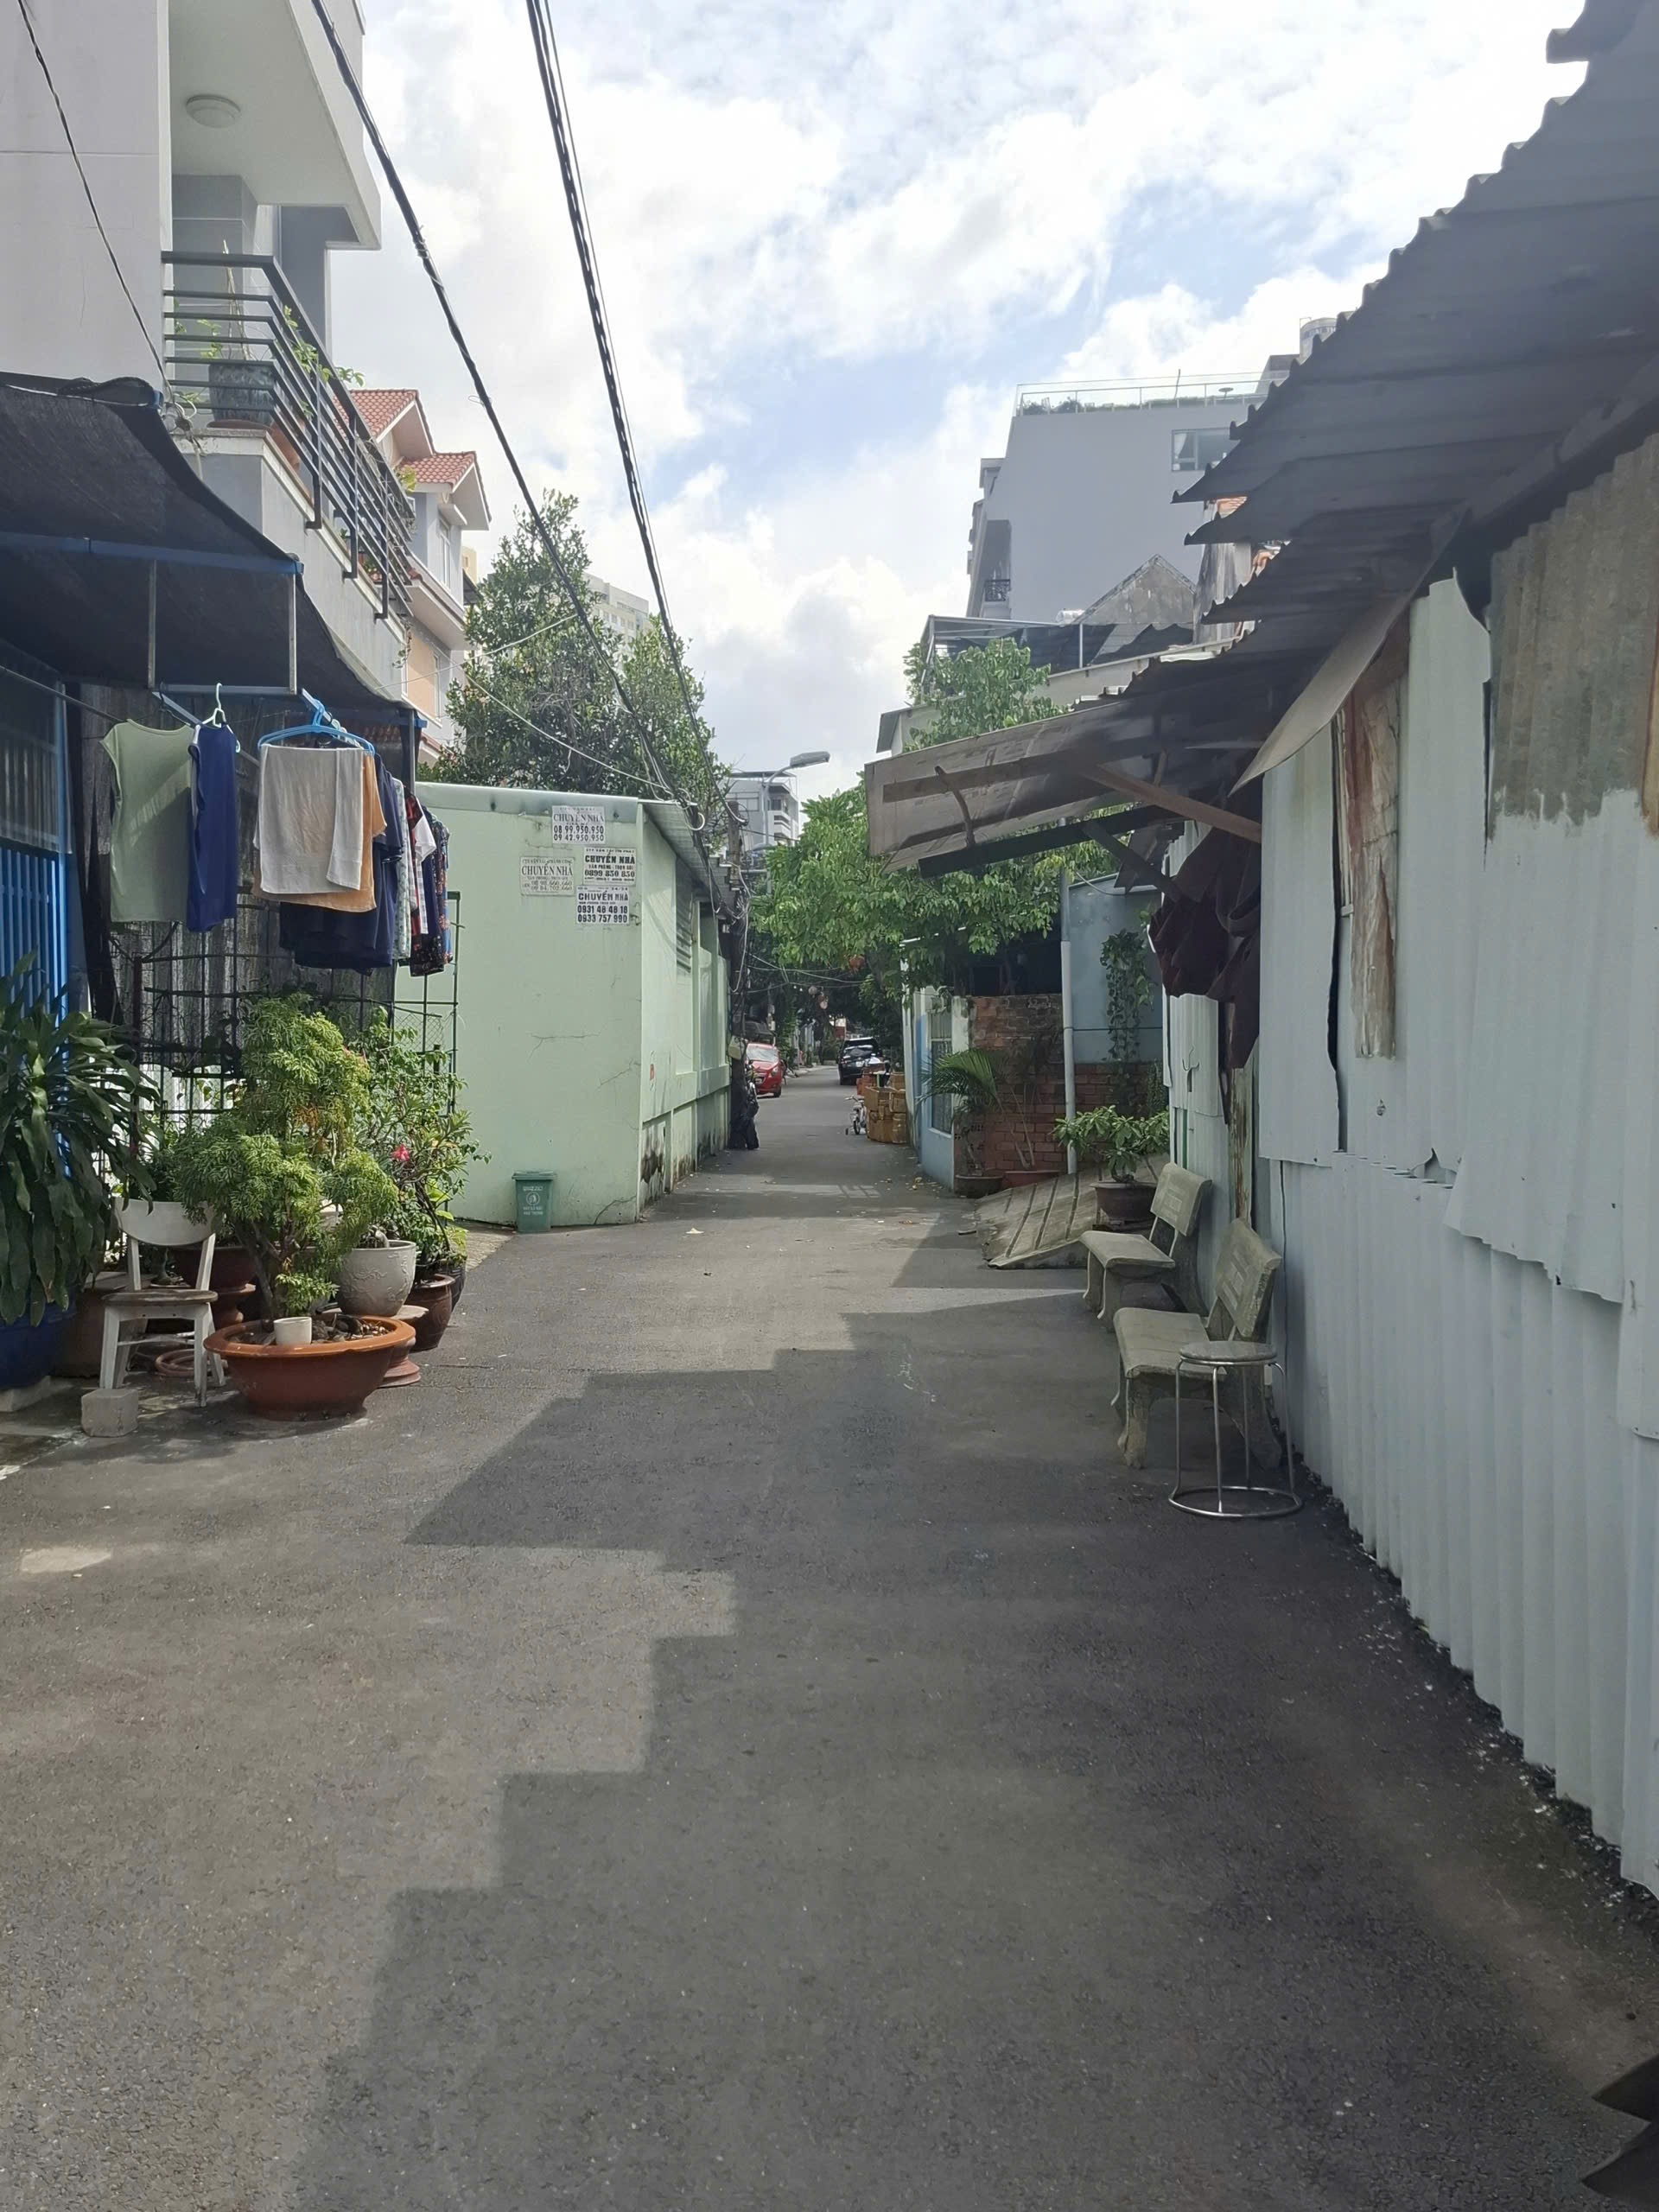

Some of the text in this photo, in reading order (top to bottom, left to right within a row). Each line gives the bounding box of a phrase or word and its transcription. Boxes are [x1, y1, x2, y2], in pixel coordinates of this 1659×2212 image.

[619, 855, 635, 864] NHÀ
[577, 905, 594, 913] 0931
[598, 914, 612, 923] 757
